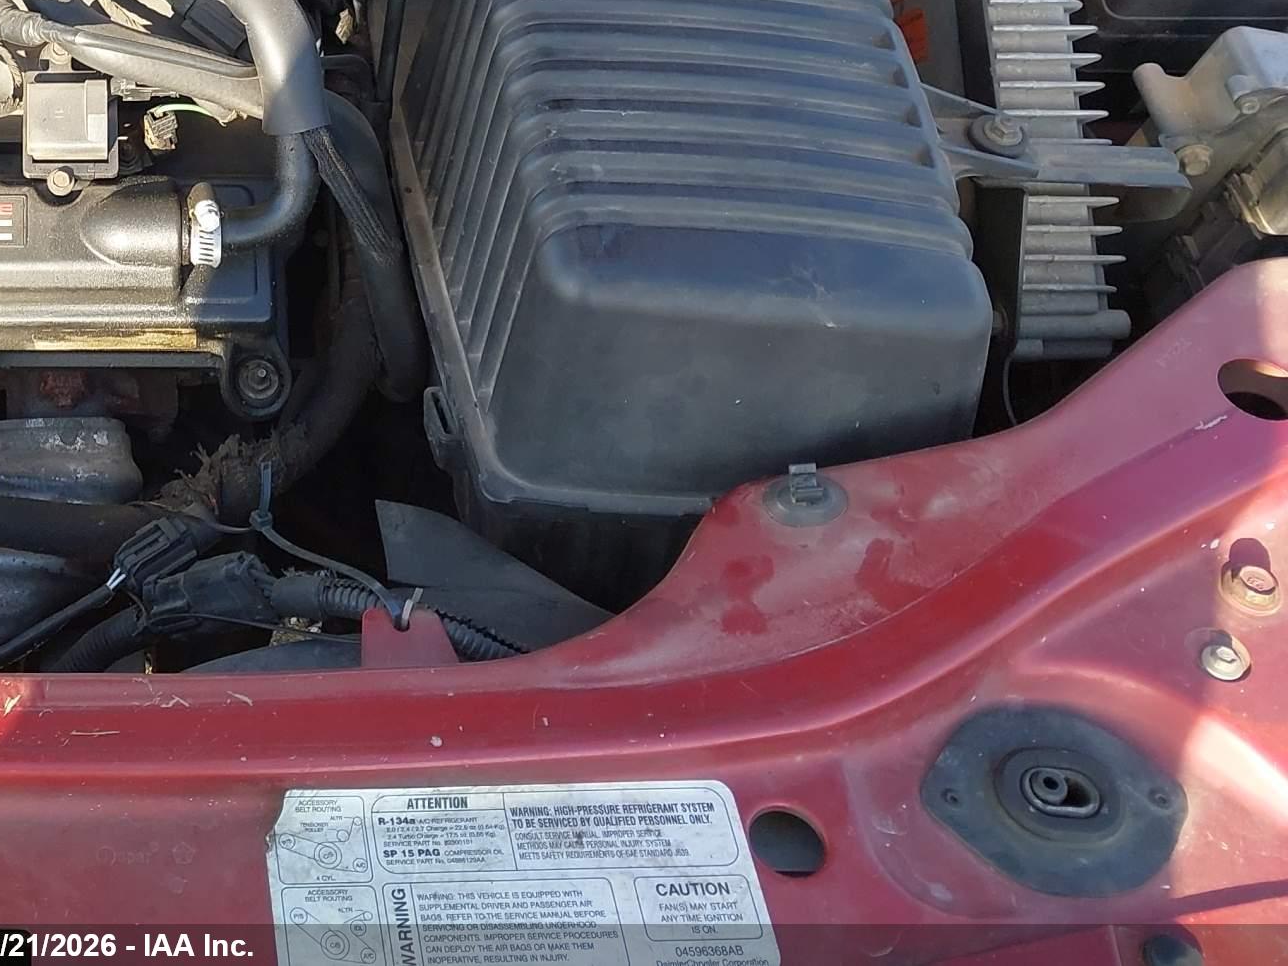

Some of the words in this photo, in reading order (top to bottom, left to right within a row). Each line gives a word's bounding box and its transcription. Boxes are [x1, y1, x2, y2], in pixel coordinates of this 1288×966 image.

[407, 796, 468, 810] ATTENTION
[510, 806, 552, 817] WARNING:
[554, 804, 621, 816] HIGH-PRESSURE
[622, 803, 679, 814] REFRIGERANT
[681, 802, 715, 813] SYSTEM
[378, 816, 416, 826] R-134a
[512, 818, 523, 829] TO
[526, 818, 536, 828] BE
[538, 817, 578, 828] SERVICED
[580, 816, 591, 827] BY
[593, 815, 636, 826] QUALIFIED
[638, 814, 688, 825] PERSONNEL
[689, 813, 712, 825] ONLY.
[514, 832, 543, 840] CONSULT
[544, 831, 570, 839] SERVICE
[601, 830, 635, 838] IMPROPER
[636, 829, 662, 837] SERVICE
[517, 841, 548, 850] METHODS
[549, 841, 562, 849] MAY
[585, 840, 620, 848] PERSONAL
[646, 839, 671, 847] SYSTEM
[383, 849, 398, 858] SP
[401, 849, 415, 858] 15
[417, 848, 441, 857] PAG
[519, 852, 540, 860] MEETS
[542, 851, 564, 859] SAFETY
[565, 850, 615, 859] REQUIREMENTS
[639, 849, 672, 857] STANDARD
[656, 881, 730, 896] CAUTION
[457, 892, 476, 900] THIS
[477, 892, 510, 900] VEHICLE
[521, 891, 561, 899] EQUIPPED
[562, 890, 583, 898] WITH
[418, 903, 480, 911] SUPPLEMENTAL
[481, 902, 511, 910] DRIVER
[530, 900, 578, 909] PASSENGER
[579, 900, 593, 908] AIR
[659, 903, 688, 912] FAN(S)
[691, 902, 708, 911] MAY
[710, 901, 738, 910] START
[420, 913, 443, 922] BAGS.
[446, 913, 472, 921] REFER
[504, 912, 539, 920] SERVICE
[540, 910, 572, 919] MANUAL
[574, 910, 607, 918] BEFORE
[661, 914, 678, 922] ANY
[680, 914, 702, 922] TIME
[704, 913, 743, 922] IGNITION
[392, 888, 416, 966] WARNING
[422, 923, 465, 932] SERVICING
[466, 923, 479, 931] OR
[480, 922, 544, 931] DISASSEMBLING
[545, 921, 597, 929] UNDERHOOD
[691, 925, 701, 934] IS
[702, 925, 718, 934] ON.
[423, 934, 481, 943] COMPONENTS.
[483, 933, 526, 942] IMPROPER
[527, 932, 563, 941] SERVICE
[563, 930, 619, 940] PROCEDURES
[425, 945, 443, 954] CAN
[444, 945, 475, 954] DEPLOY
[478, 944, 494, 953] THE
[495, 944, 509, 952] AIR
[510, 943, 532, 952] BAGS
[533, 943, 547, 951] OR
[548, 942, 570, 951] MAKE
[572, 942, 595, 950] THEM
[675, 945, 744, 957] 04596368AB
[427, 955, 481, 965] INOPERATIVE,
[483, 954, 528, 963] RESULTING
[530, 954, 538, 962] IN
[539, 953, 570, 962] INJURY.
